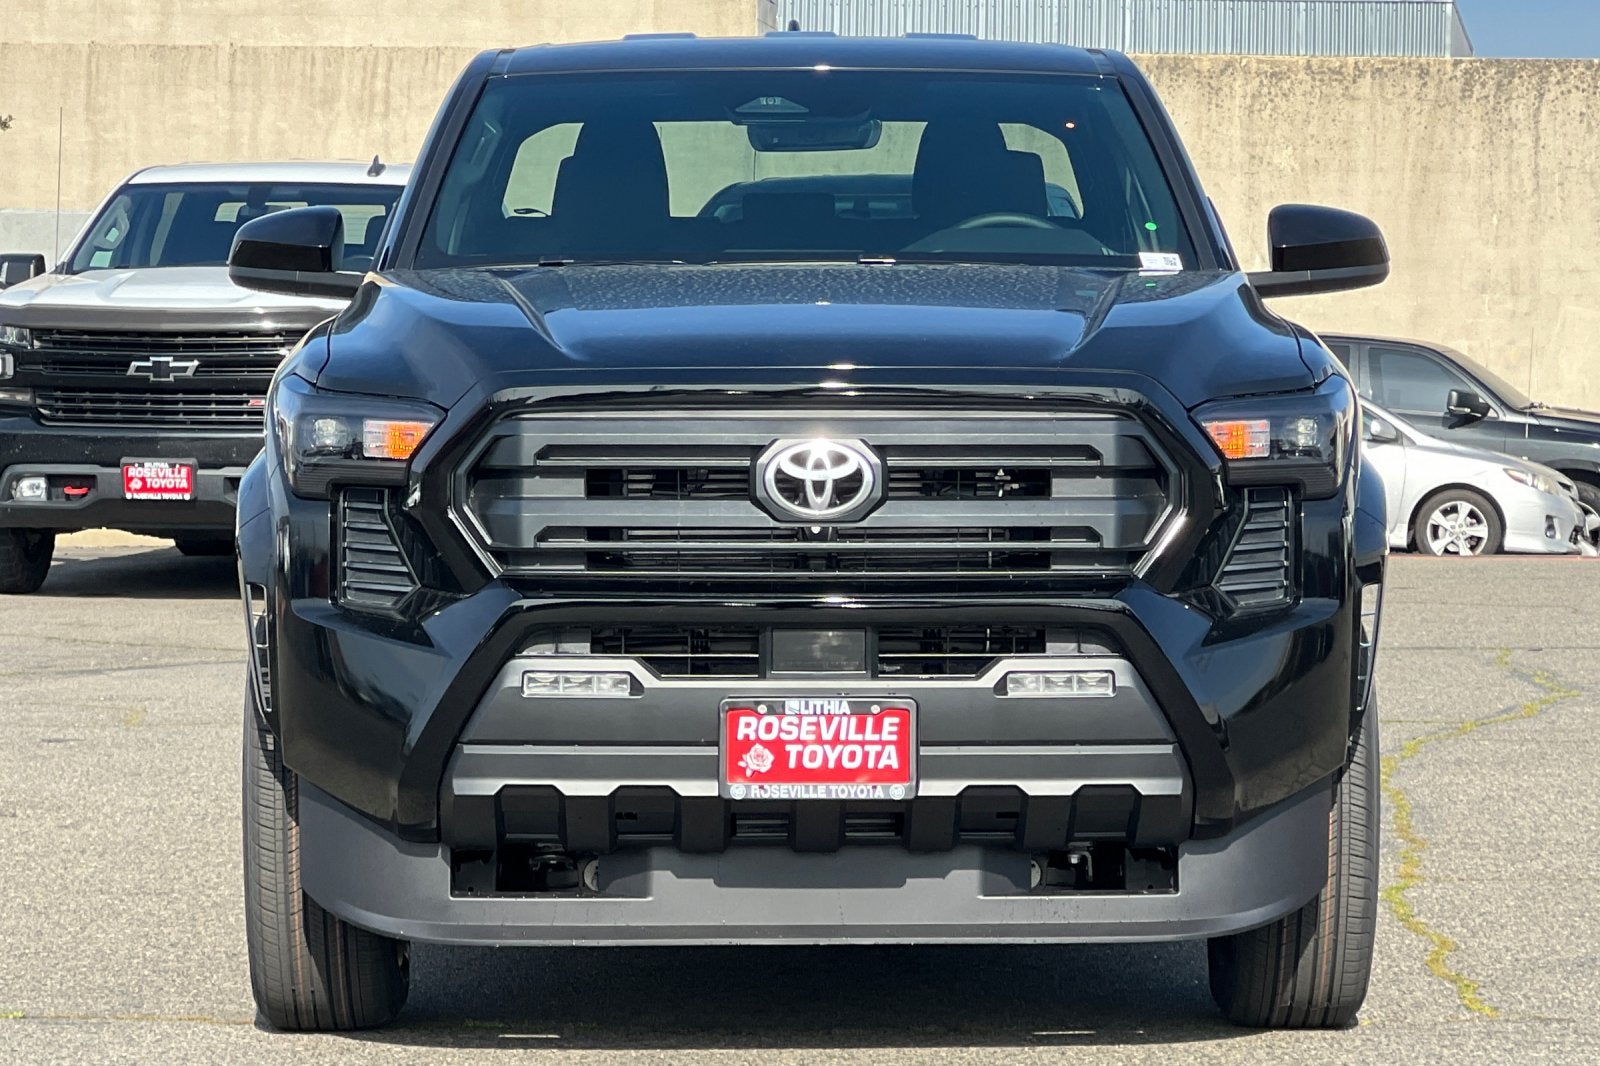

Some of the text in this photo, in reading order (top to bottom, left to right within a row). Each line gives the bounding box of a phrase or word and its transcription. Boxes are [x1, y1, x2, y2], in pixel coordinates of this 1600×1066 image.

[128, 468, 187, 477] ROSEVILLE
[146, 478, 187, 488] TOYOTA
[801, 700, 851, 714] LITHIA
[737, 716, 900, 741] ROSEVILLE
[785, 744, 899, 769] TOYOTA
[751, 785, 884, 799] ROSEVILLE TOYOTA
